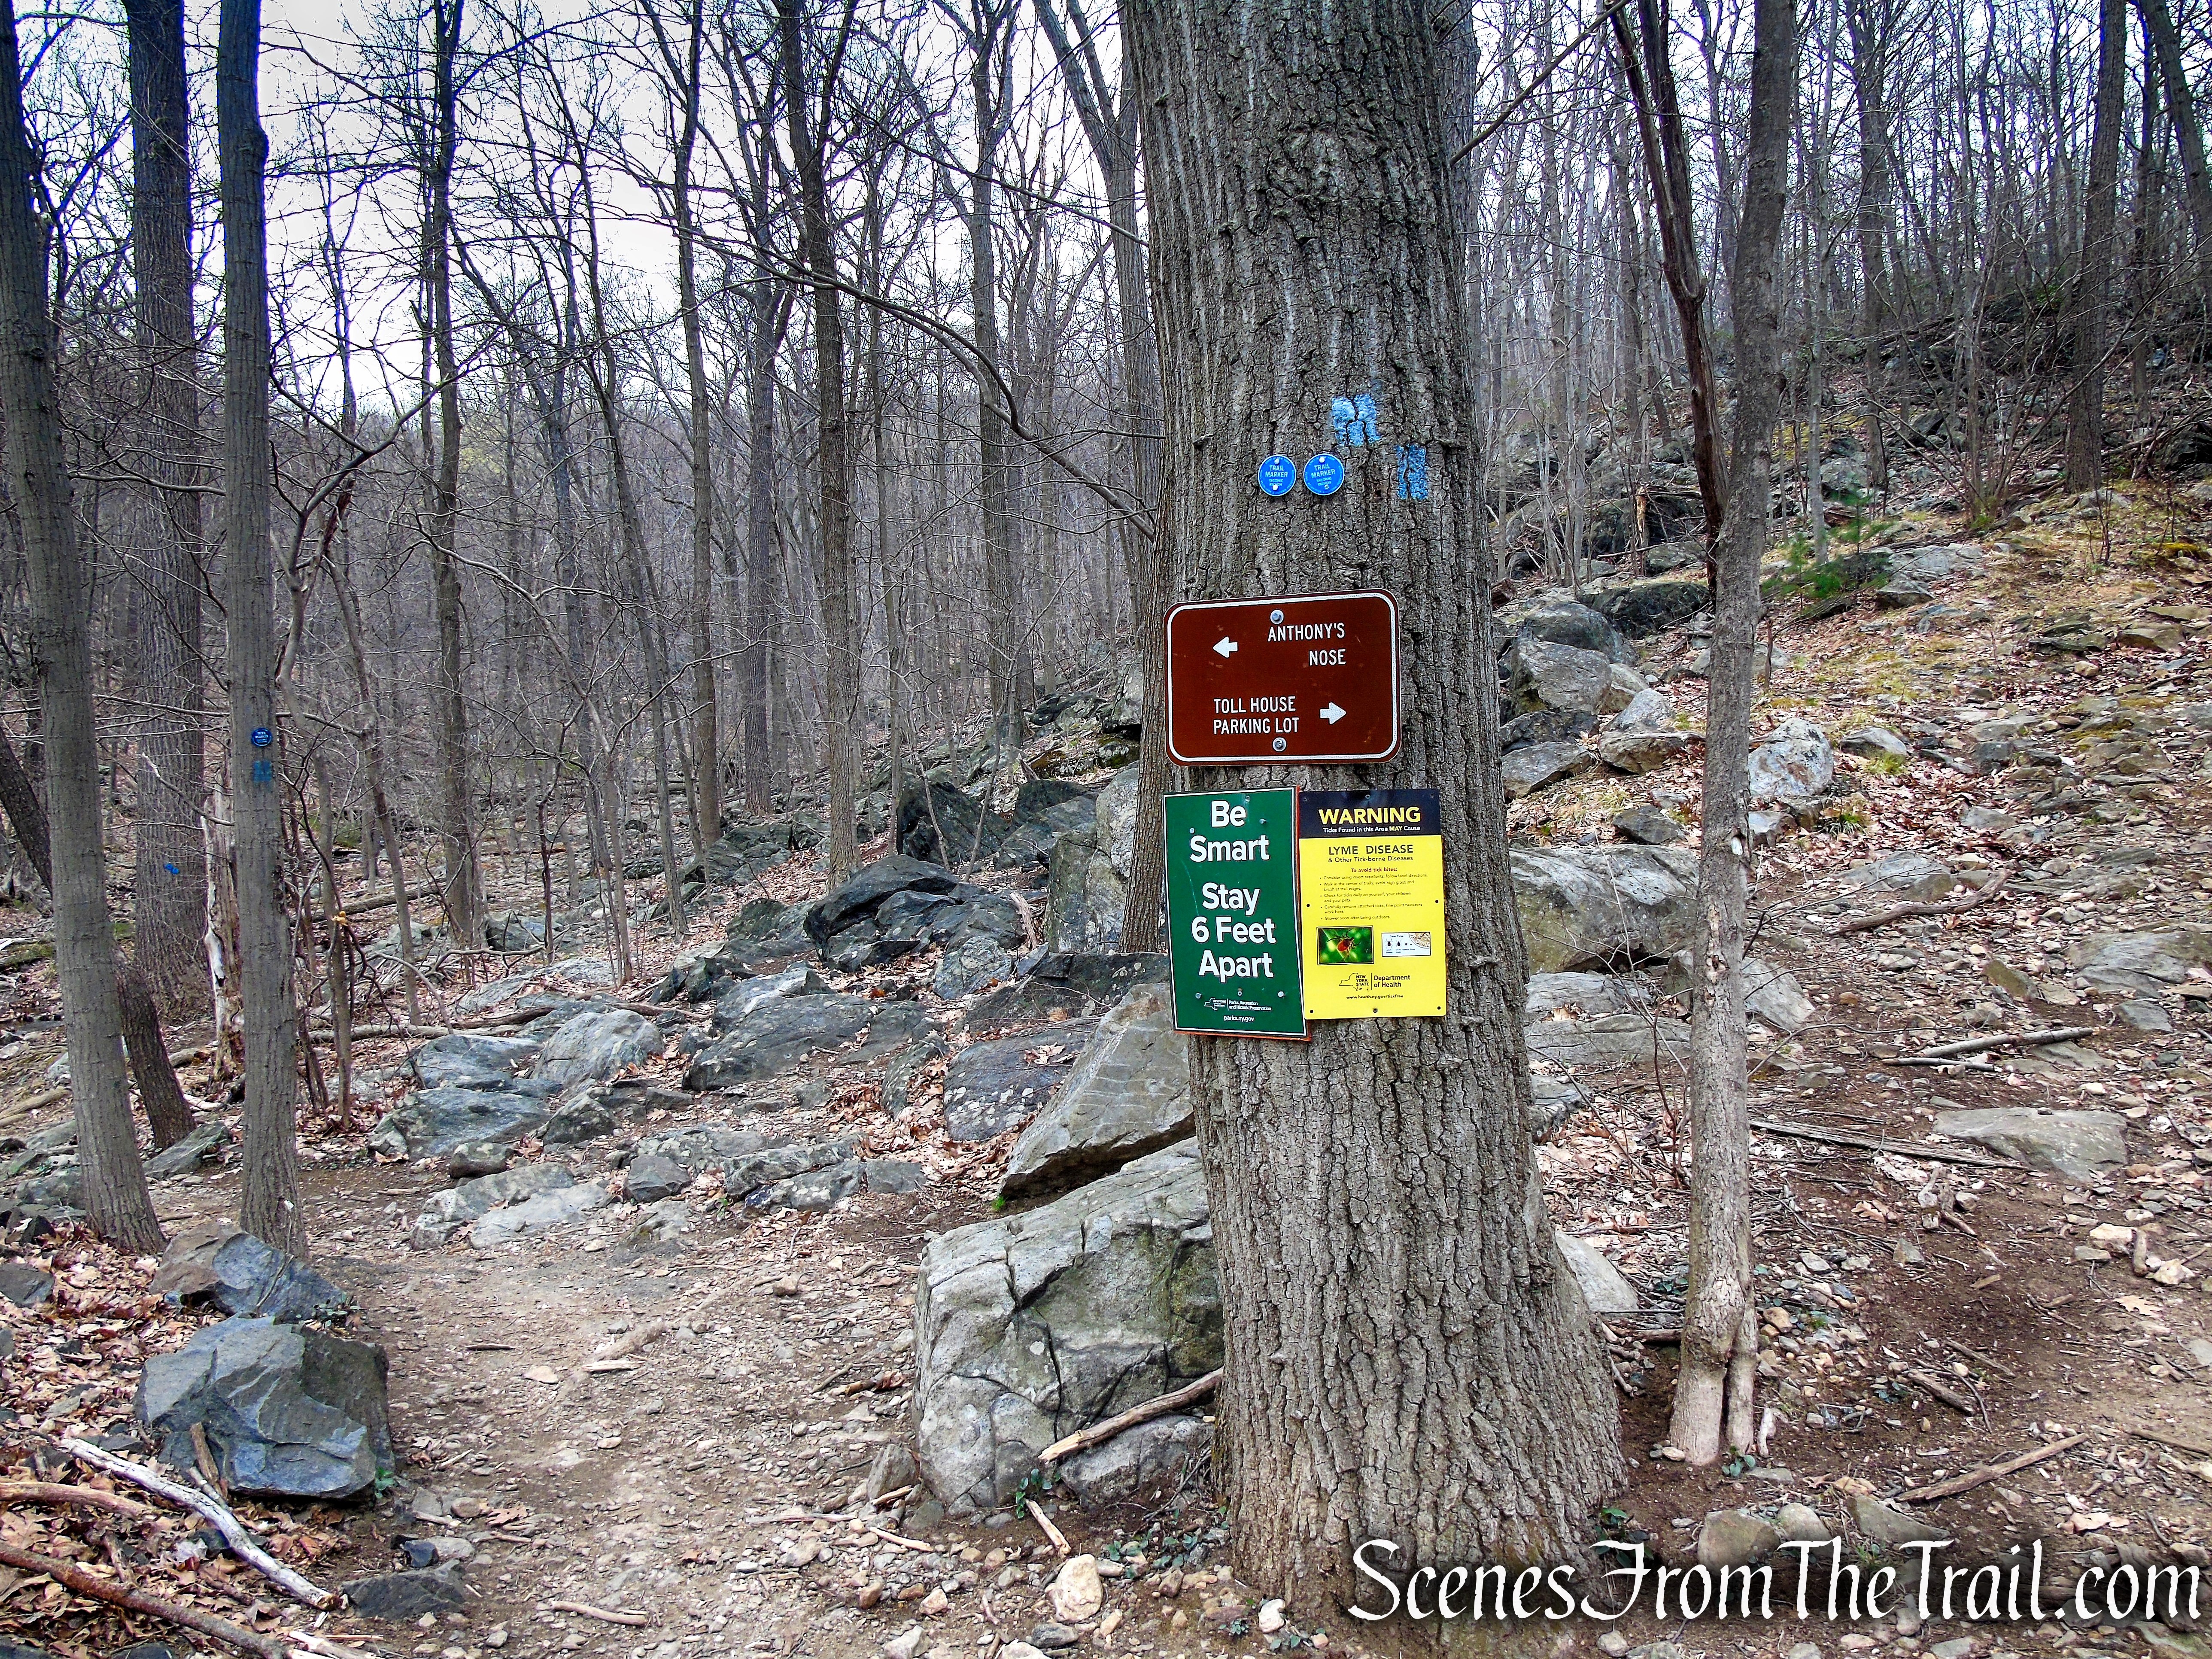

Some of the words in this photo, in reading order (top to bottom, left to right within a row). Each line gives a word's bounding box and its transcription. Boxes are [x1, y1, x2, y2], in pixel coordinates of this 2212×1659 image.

[1311, 469, 1335, 478] MARKER
[1268, 623, 1345, 641] ANTHONY'S
[1310, 649, 1346, 665] NOSE
[1214, 698, 1246, 714] TOLL
[1251, 696, 1296, 712] HOUSE
[1214, 718, 1270, 734] PARKING
[1276, 717, 1299, 733] LOT
[1211, 800, 1246, 827] Be
[1318, 807, 1420, 824] WARNING
[1190, 835, 1270, 862] Smart
[1329, 846, 1358, 855] LYME
[1366, 845, 1413, 854] DISEASE
[1202, 882, 1260, 916] Stay
[1191, 916, 1209, 943] 6
[1216, 916, 1276, 943] Feet
[1198, 950, 1273, 983] Apart
